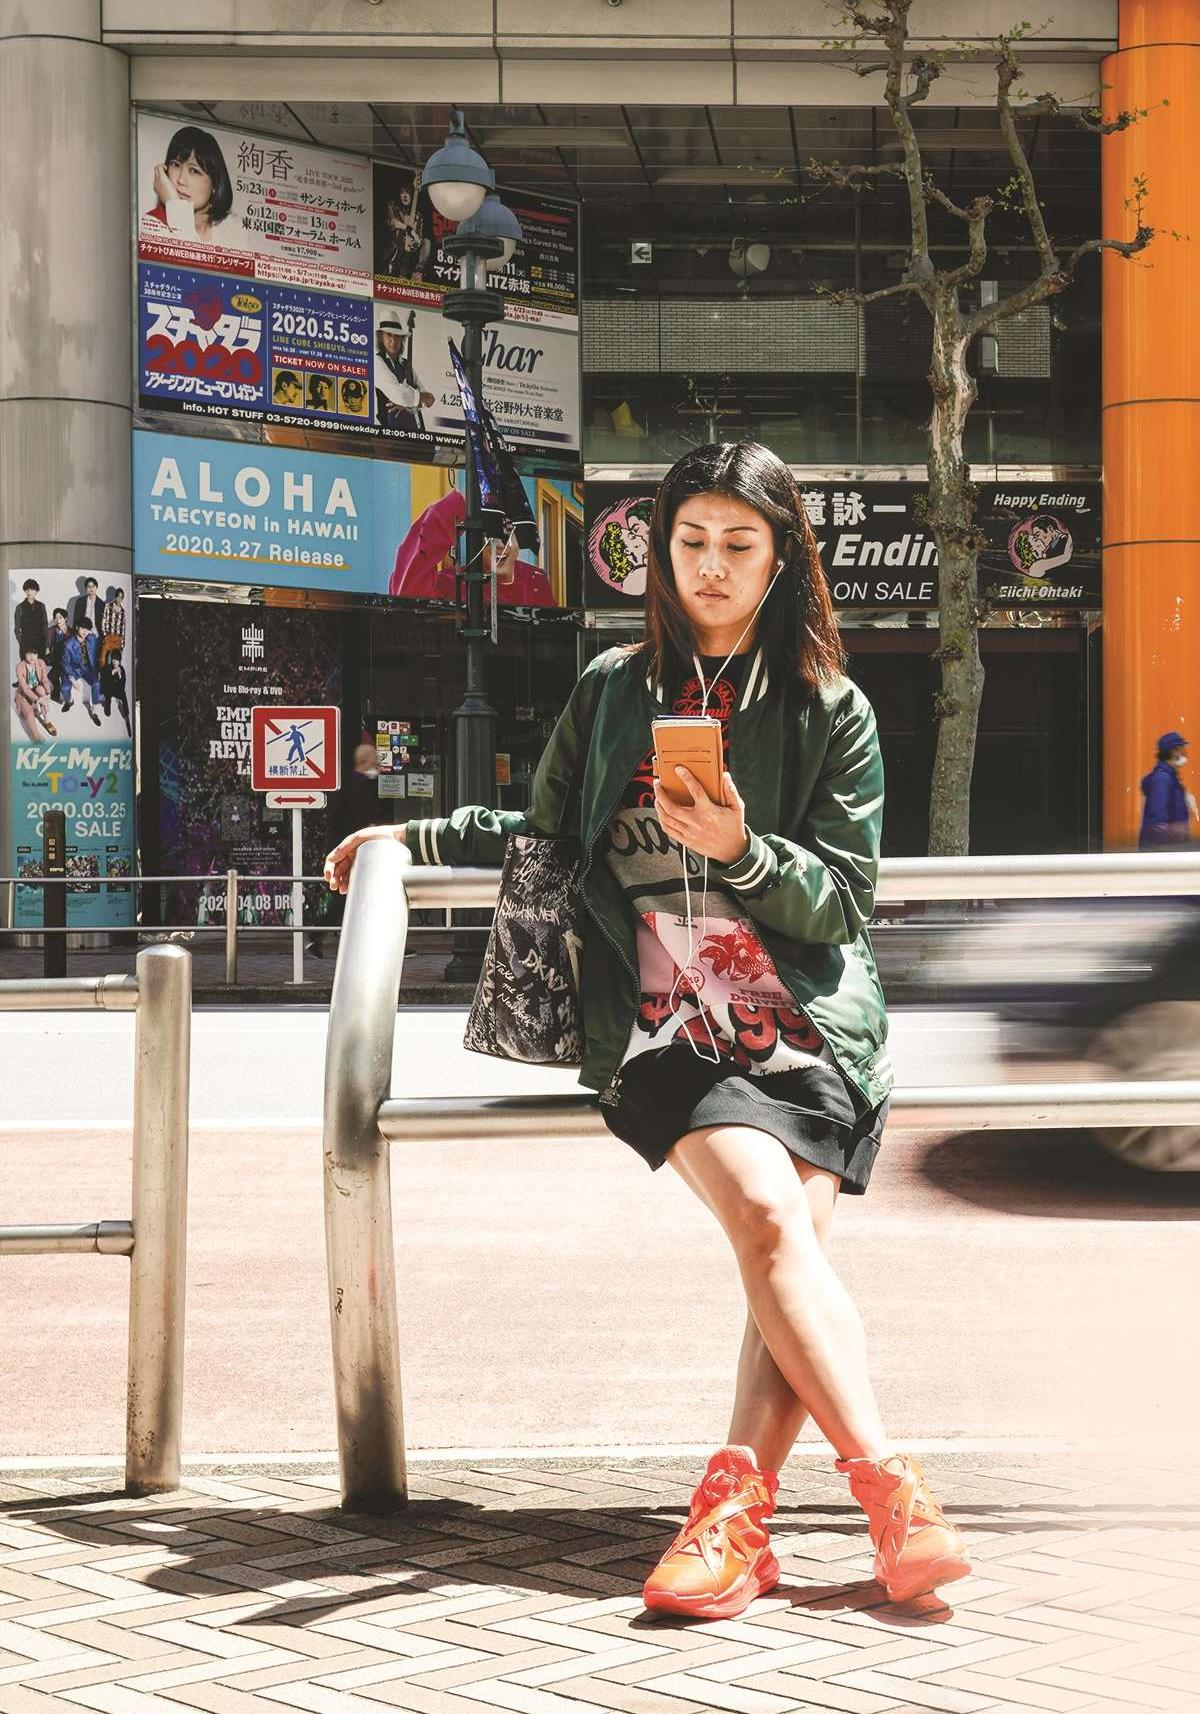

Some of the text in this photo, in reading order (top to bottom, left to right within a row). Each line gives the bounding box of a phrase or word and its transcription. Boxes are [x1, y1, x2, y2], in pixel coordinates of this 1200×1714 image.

[299, 193, 366, 215] サンシティホール
[242, 217, 326, 242] 東京国際フォーラム
[329, 234, 362, 249] ホールA
[272, 312, 350, 342] 2020.5.5
[314, 341, 346, 353] SHIBUYA
[145, 334, 263, 385] 2020
[274, 355, 367, 375] TICKET NOW ON SALE!!
[208, 405, 230, 416] HOT
[231, 408, 264, 420] STUFF
[151, 457, 357, 518] ALOHA
[994, 494, 1086, 509] Happy Ending
[151, 504, 358, 541] TAECYEON in HAWAII
[166, 533, 345, 567] 2020.3.27 Release
[832, 534, 939, 567] Endin
[834, 582, 934, 601] ON SALE
[1038, 585, 1083, 599] Ohtaki
[223, 685, 237, 694] Live
[238, 685, 262, 696] Blu-ray
[216, 706, 251, 721] EMP
[209, 741, 251, 759] REV
[268, 765, 308, 776] 横断禁止
[75, 821, 122, 837] SALE
